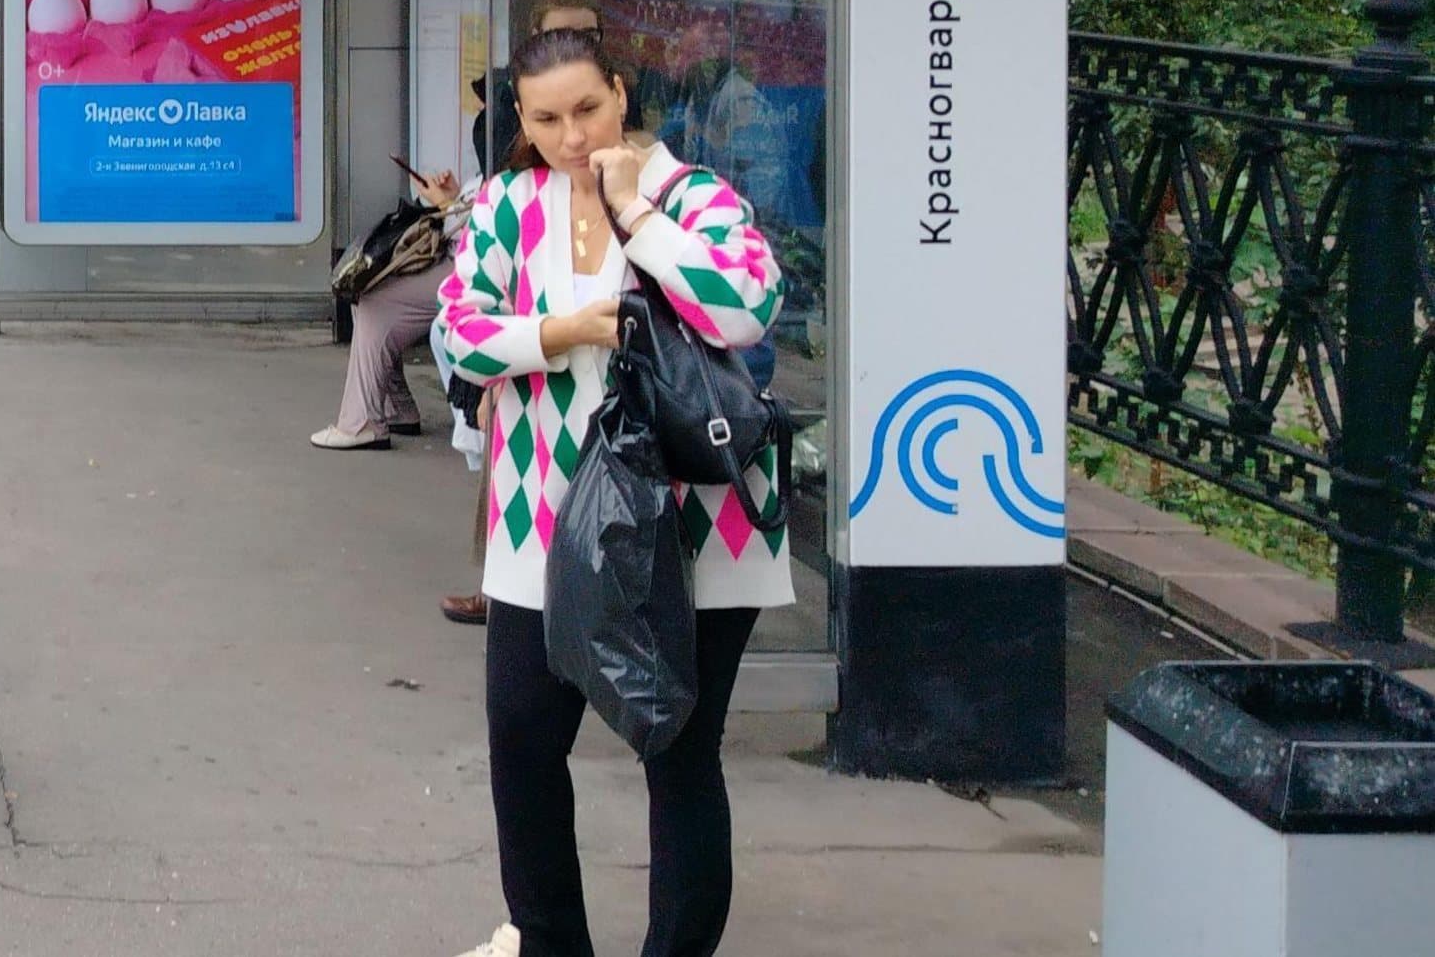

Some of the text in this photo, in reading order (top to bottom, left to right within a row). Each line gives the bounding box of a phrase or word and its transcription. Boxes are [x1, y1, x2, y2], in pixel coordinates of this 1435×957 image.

[223, 30, 292, 61] очень
[38, 61, 65, 80] 0+
[84, 101, 246, 125] Яндекс Лавка
[108, 134, 222, 150] Магазин и кафе
